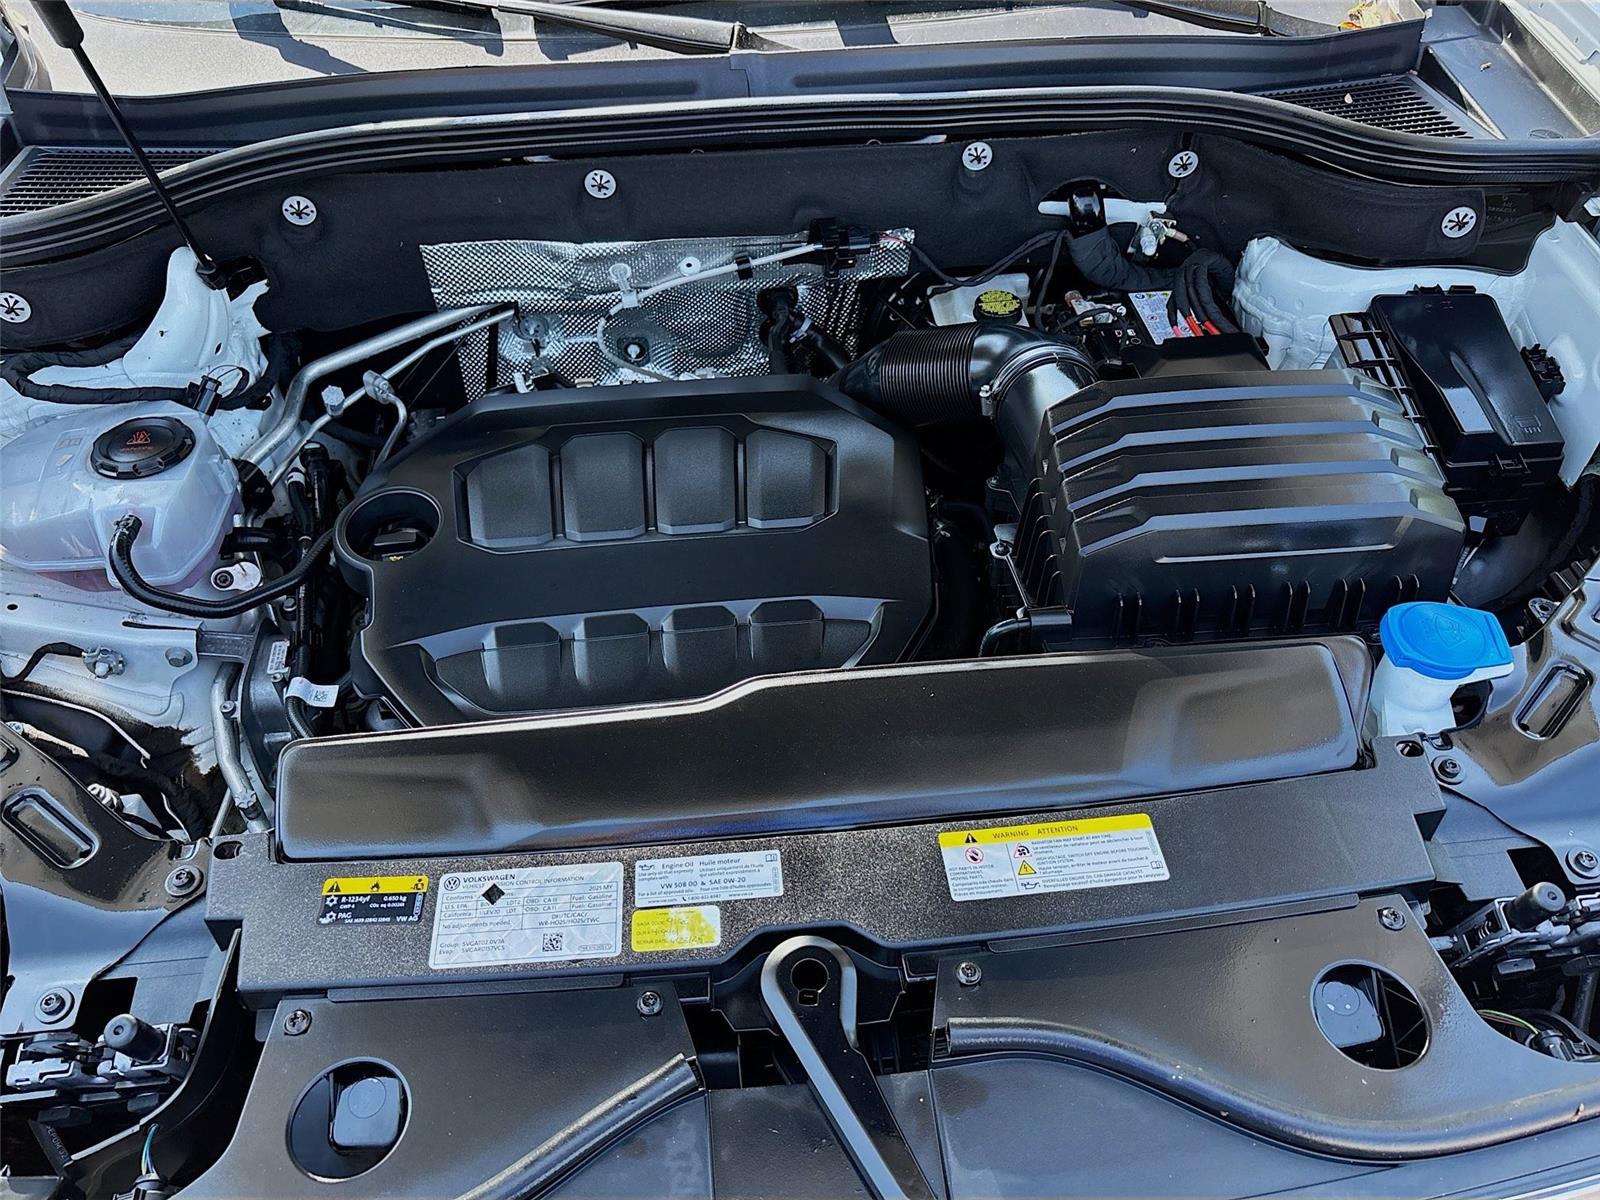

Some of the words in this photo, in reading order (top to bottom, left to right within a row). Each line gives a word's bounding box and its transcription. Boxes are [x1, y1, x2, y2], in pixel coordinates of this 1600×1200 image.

[992, 829, 1029, 839] WARNING
[1037, 825, 1078, 835] ATTENTION
[463, 874, 516, 883] VOLKSWAGEN
[544, 876, 585, 884] INFORMATION
[340, 895, 371, 904] R-1234yf
[400, 895, 407, 903] kg
